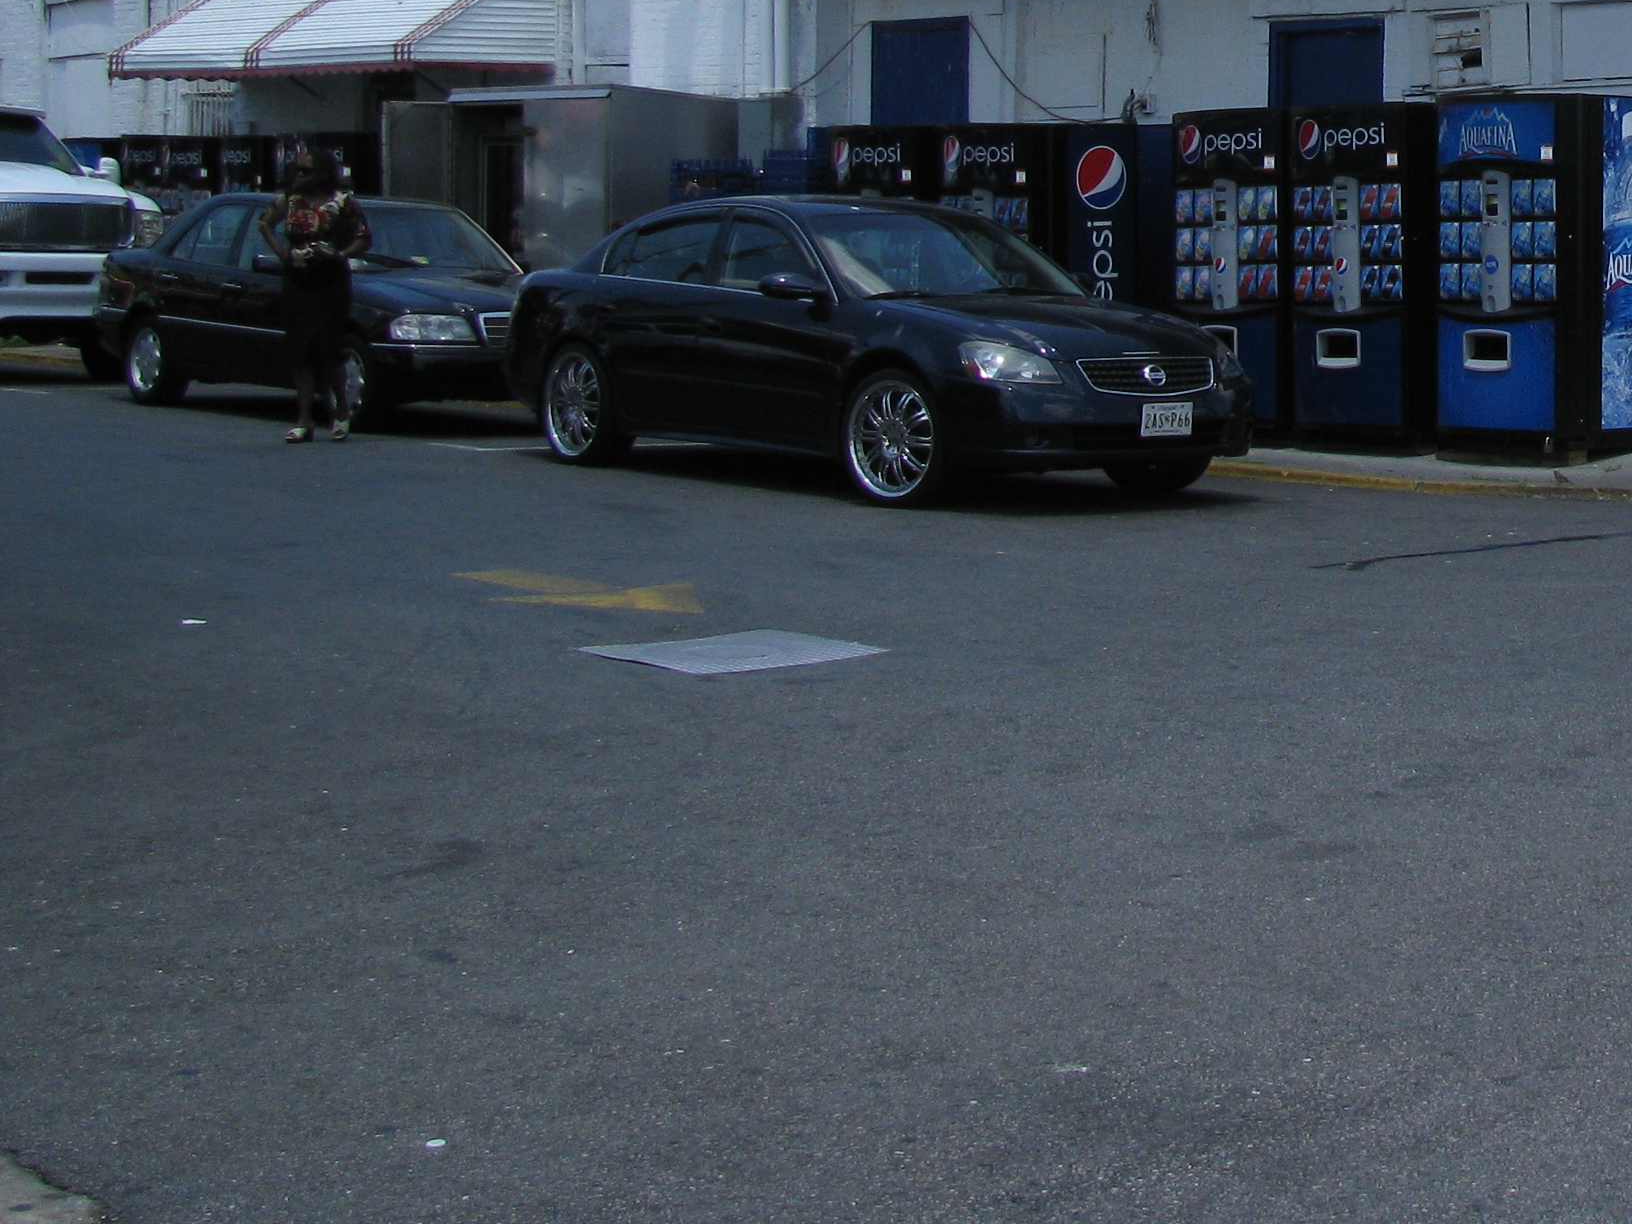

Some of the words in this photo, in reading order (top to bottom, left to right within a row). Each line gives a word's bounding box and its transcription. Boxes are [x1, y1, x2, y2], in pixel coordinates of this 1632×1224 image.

[1204, 128, 1263, 156] pepsi
[1324, 122, 1385, 151] pepsi
[1459, 122, 1517, 156] AQUAFINA
[171, 148, 202, 166] pepsi
[852, 143, 901, 166] pepsi
[963, 142, 1015, 167] pepsi
[1086, 220, 1119, 301] epsi
